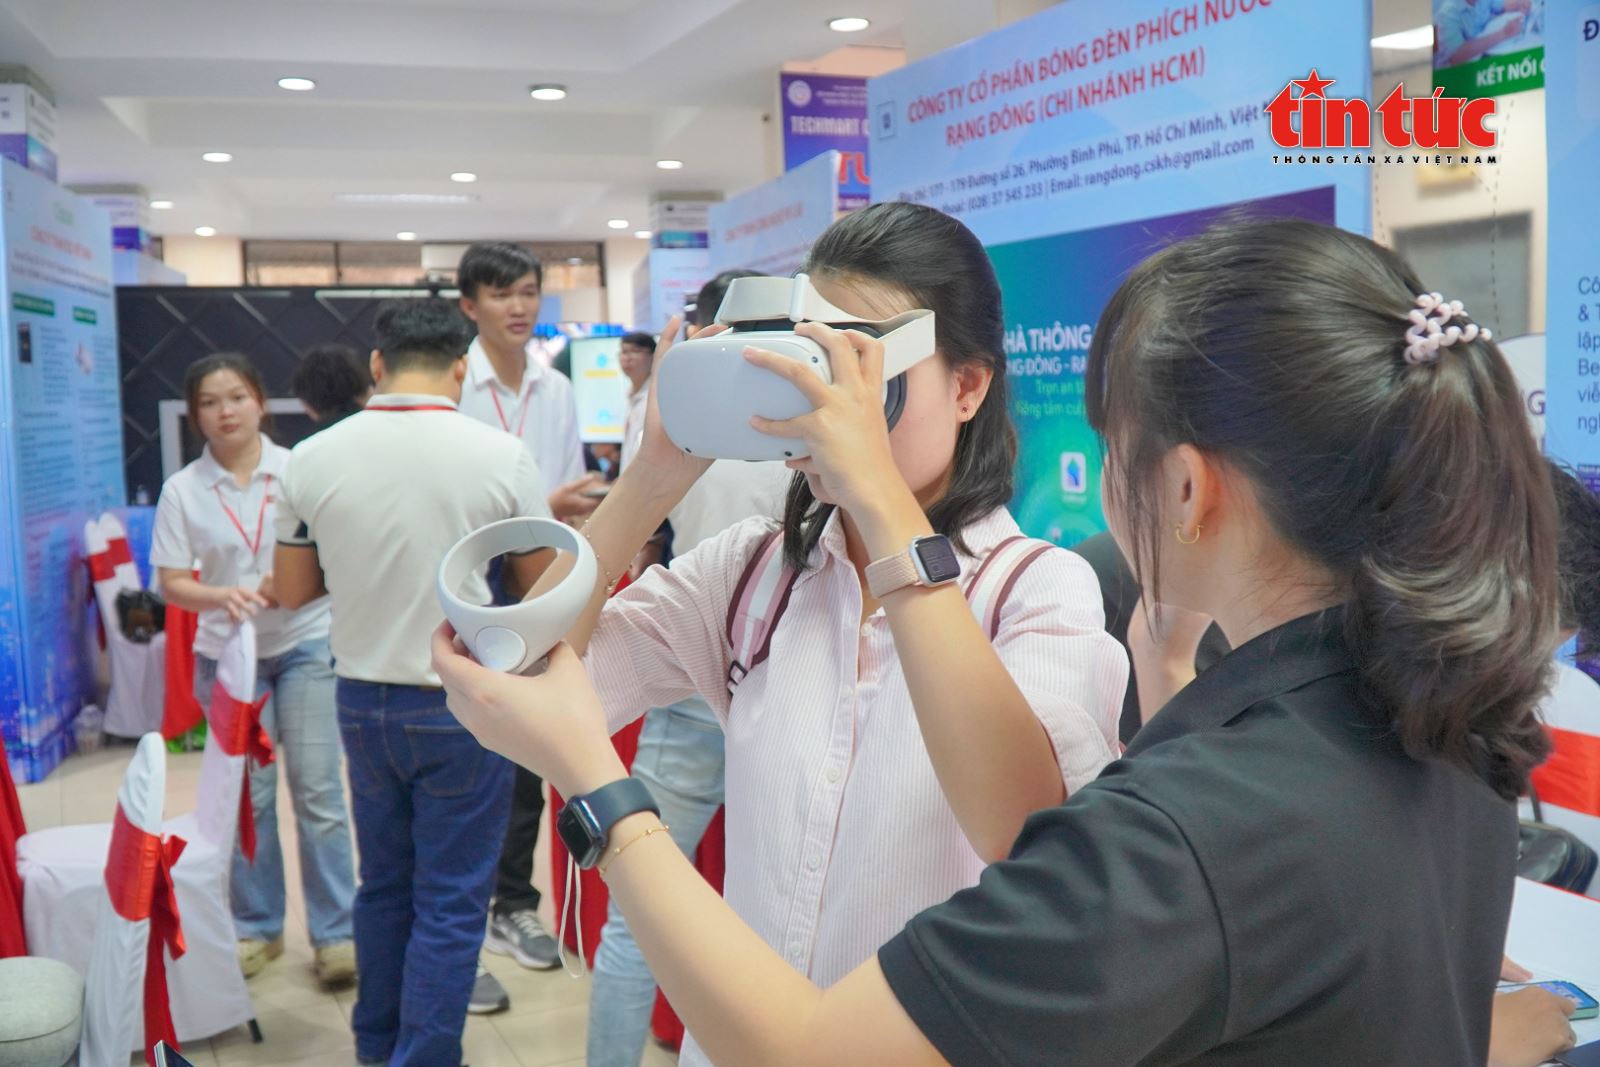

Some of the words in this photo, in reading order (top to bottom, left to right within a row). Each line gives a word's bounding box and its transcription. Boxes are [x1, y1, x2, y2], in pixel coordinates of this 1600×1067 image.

[908, 92, 945, 124] CÔNG
[948, 85, 965, 112] TY
[1039, 43, 1087, 81] BÓNG
[1091, 26, 1130, 64] ĐÈN
[1135, 4, 1198, 48] PHÍCH
[1476, 61, 1504, 87] KẾT
[946, 114, 986, 149] RẠNG
[989, 103, 1036, 135] ĐÔNG
[1040, 85, 1073, 122] (CHI
[1077, 65, 1145, 109] NHÁNH
[1151, 45, 1206, 88] HCM)
[1230, 102, 1259, 128] Việt
[1051, 173, 1081, 194] Email:
[1084, 137, 1255, 187] rangdong.cskh@gmail.com
[1029, 321, 1092, 352] THÔNG
